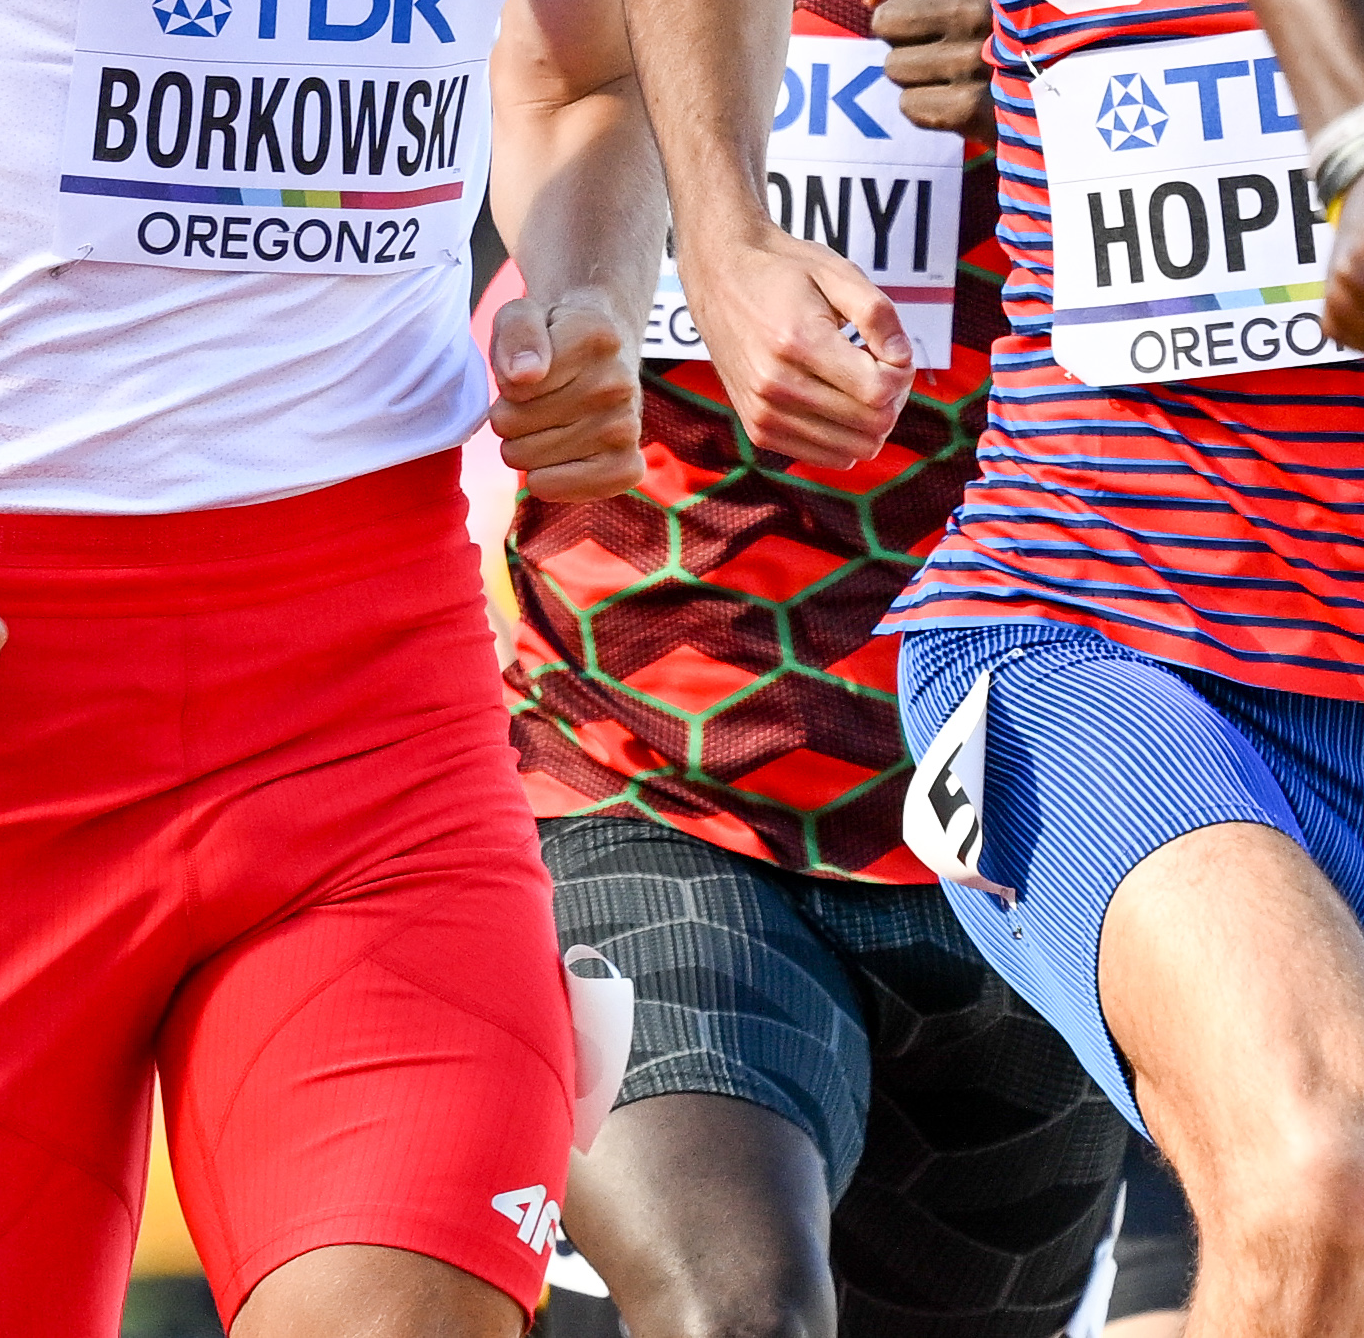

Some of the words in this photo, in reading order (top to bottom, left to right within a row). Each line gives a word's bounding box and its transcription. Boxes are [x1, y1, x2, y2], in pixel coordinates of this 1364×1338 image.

[92, 66, 470, 177] BORKOWSKI
[137, 211, 420, 264] OREGON22
[1087, 167, 1330, 288] HOPP
[1130, 312, 1346, 374] OREGO
